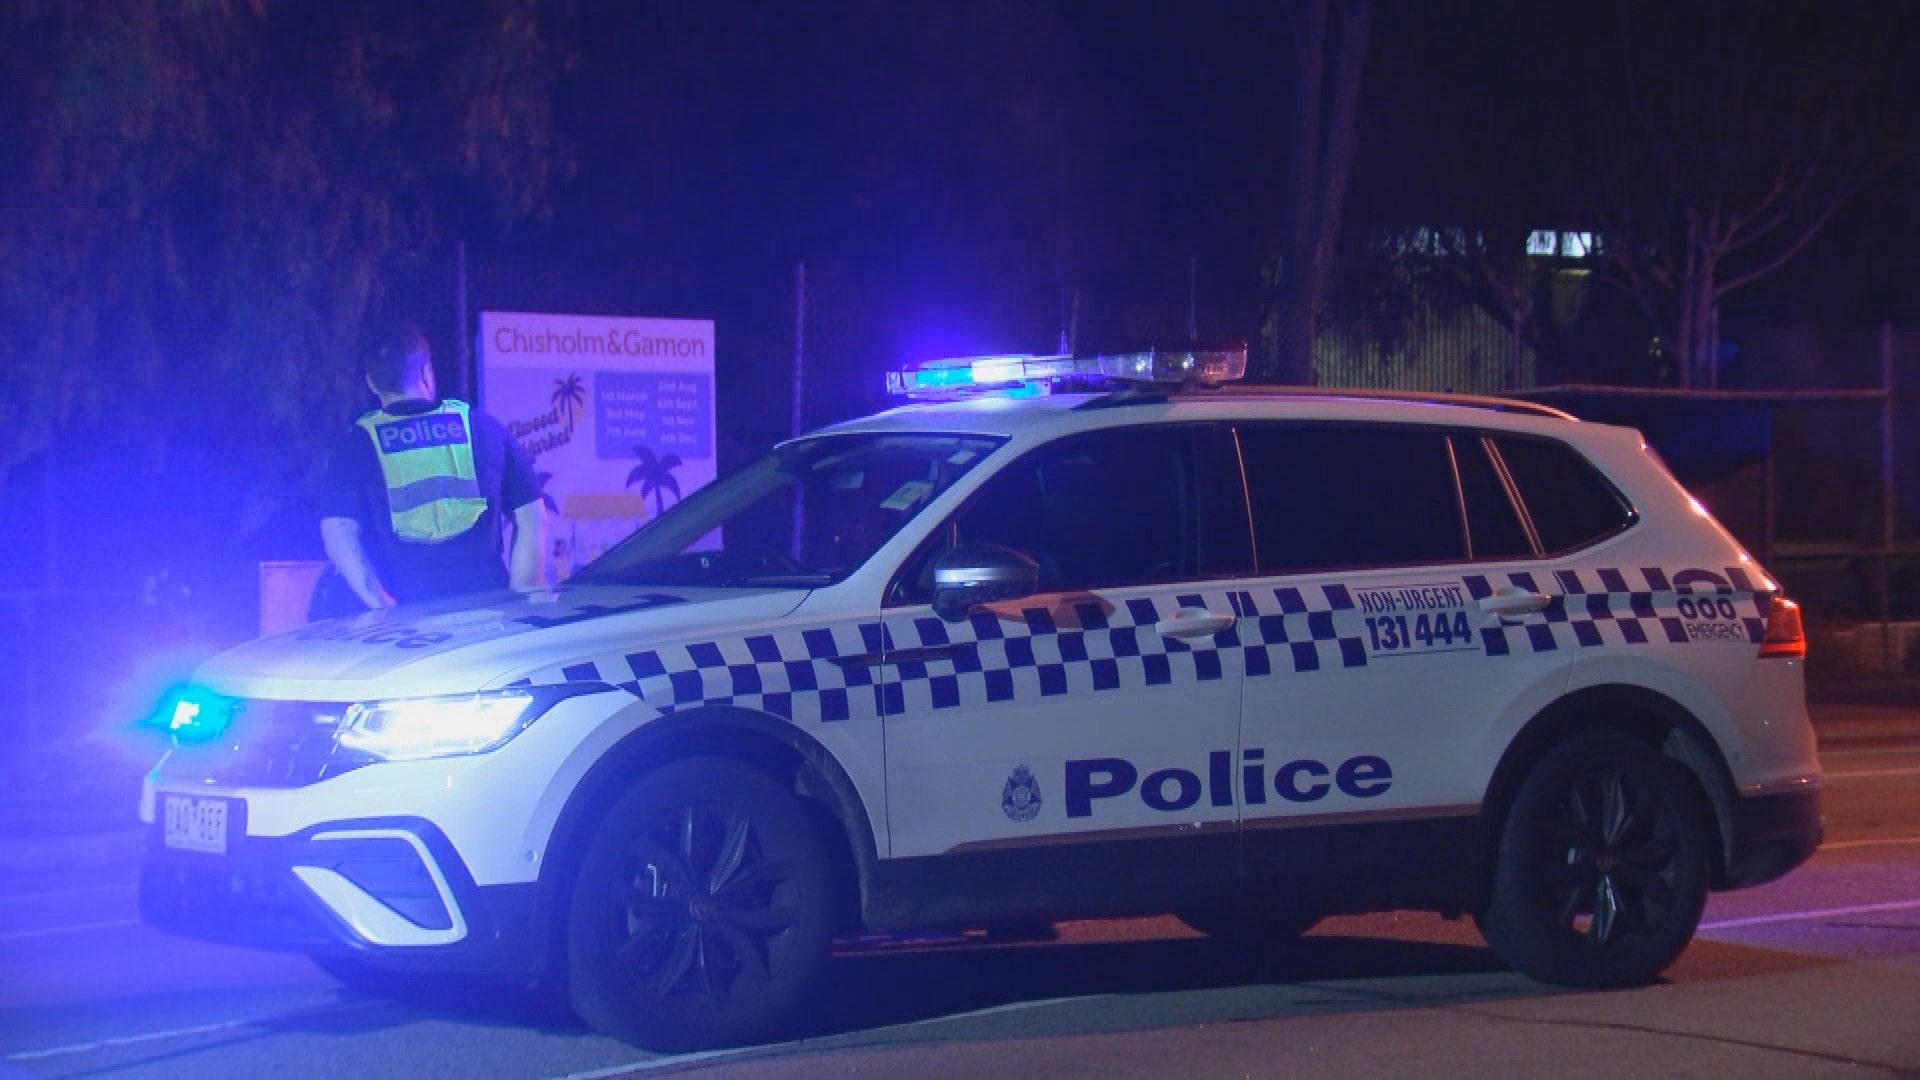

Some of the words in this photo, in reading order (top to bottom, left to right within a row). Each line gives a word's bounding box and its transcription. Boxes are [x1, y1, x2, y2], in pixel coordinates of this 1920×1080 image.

[494, 327, 705, 357] Chisholm&Gamon
[380, 419, 464, 449] Police
[1357, 586, 1464, 615] NON-URGENT
[1676, 597, 1736, 619] 000
[1365, 615, 1411, 651] 131
[1415, 611, 1472, 647] 444
[1686, 623, 1745, 639] EMERGENCY
[1064, 747, 1393, 819] Police
